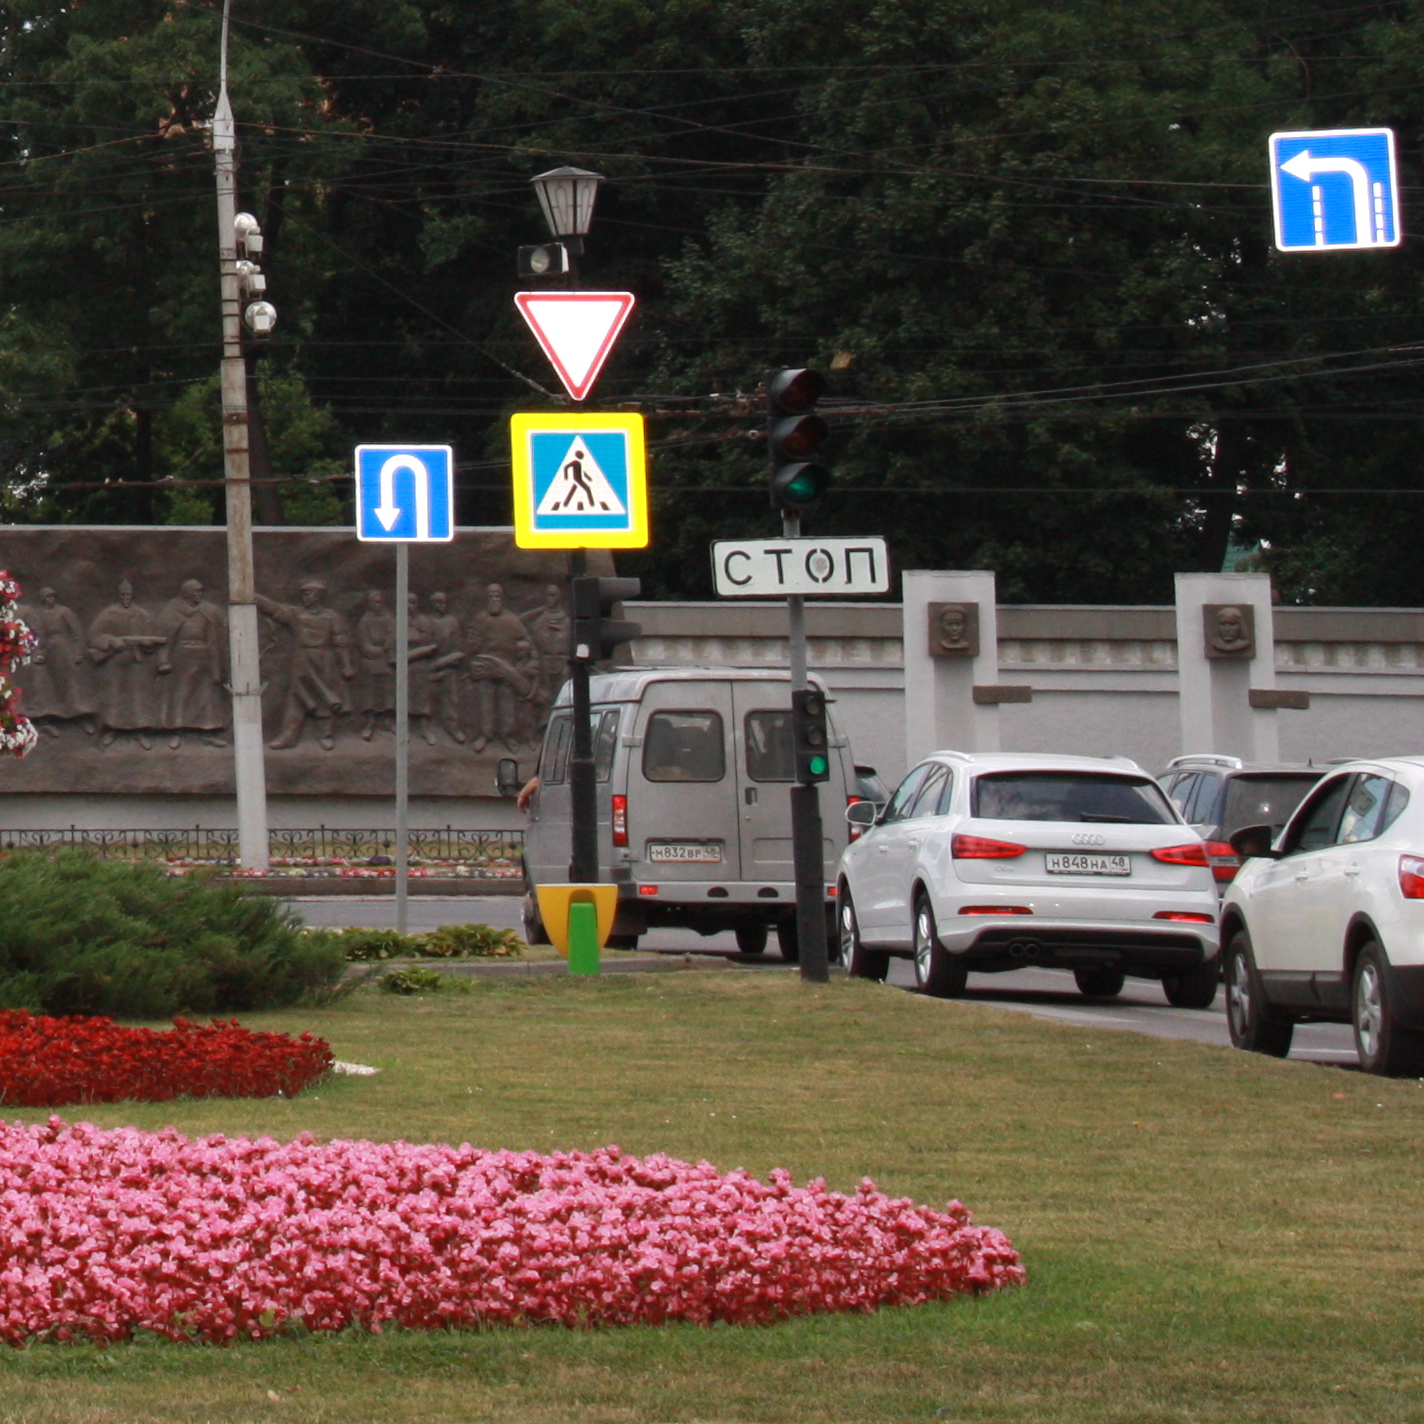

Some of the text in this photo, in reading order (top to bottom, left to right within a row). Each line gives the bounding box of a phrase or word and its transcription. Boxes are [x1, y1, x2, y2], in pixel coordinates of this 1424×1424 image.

[724, 547, 877, 586] СТОП
[1051, 855, 1125, 870] Н848НА 48
